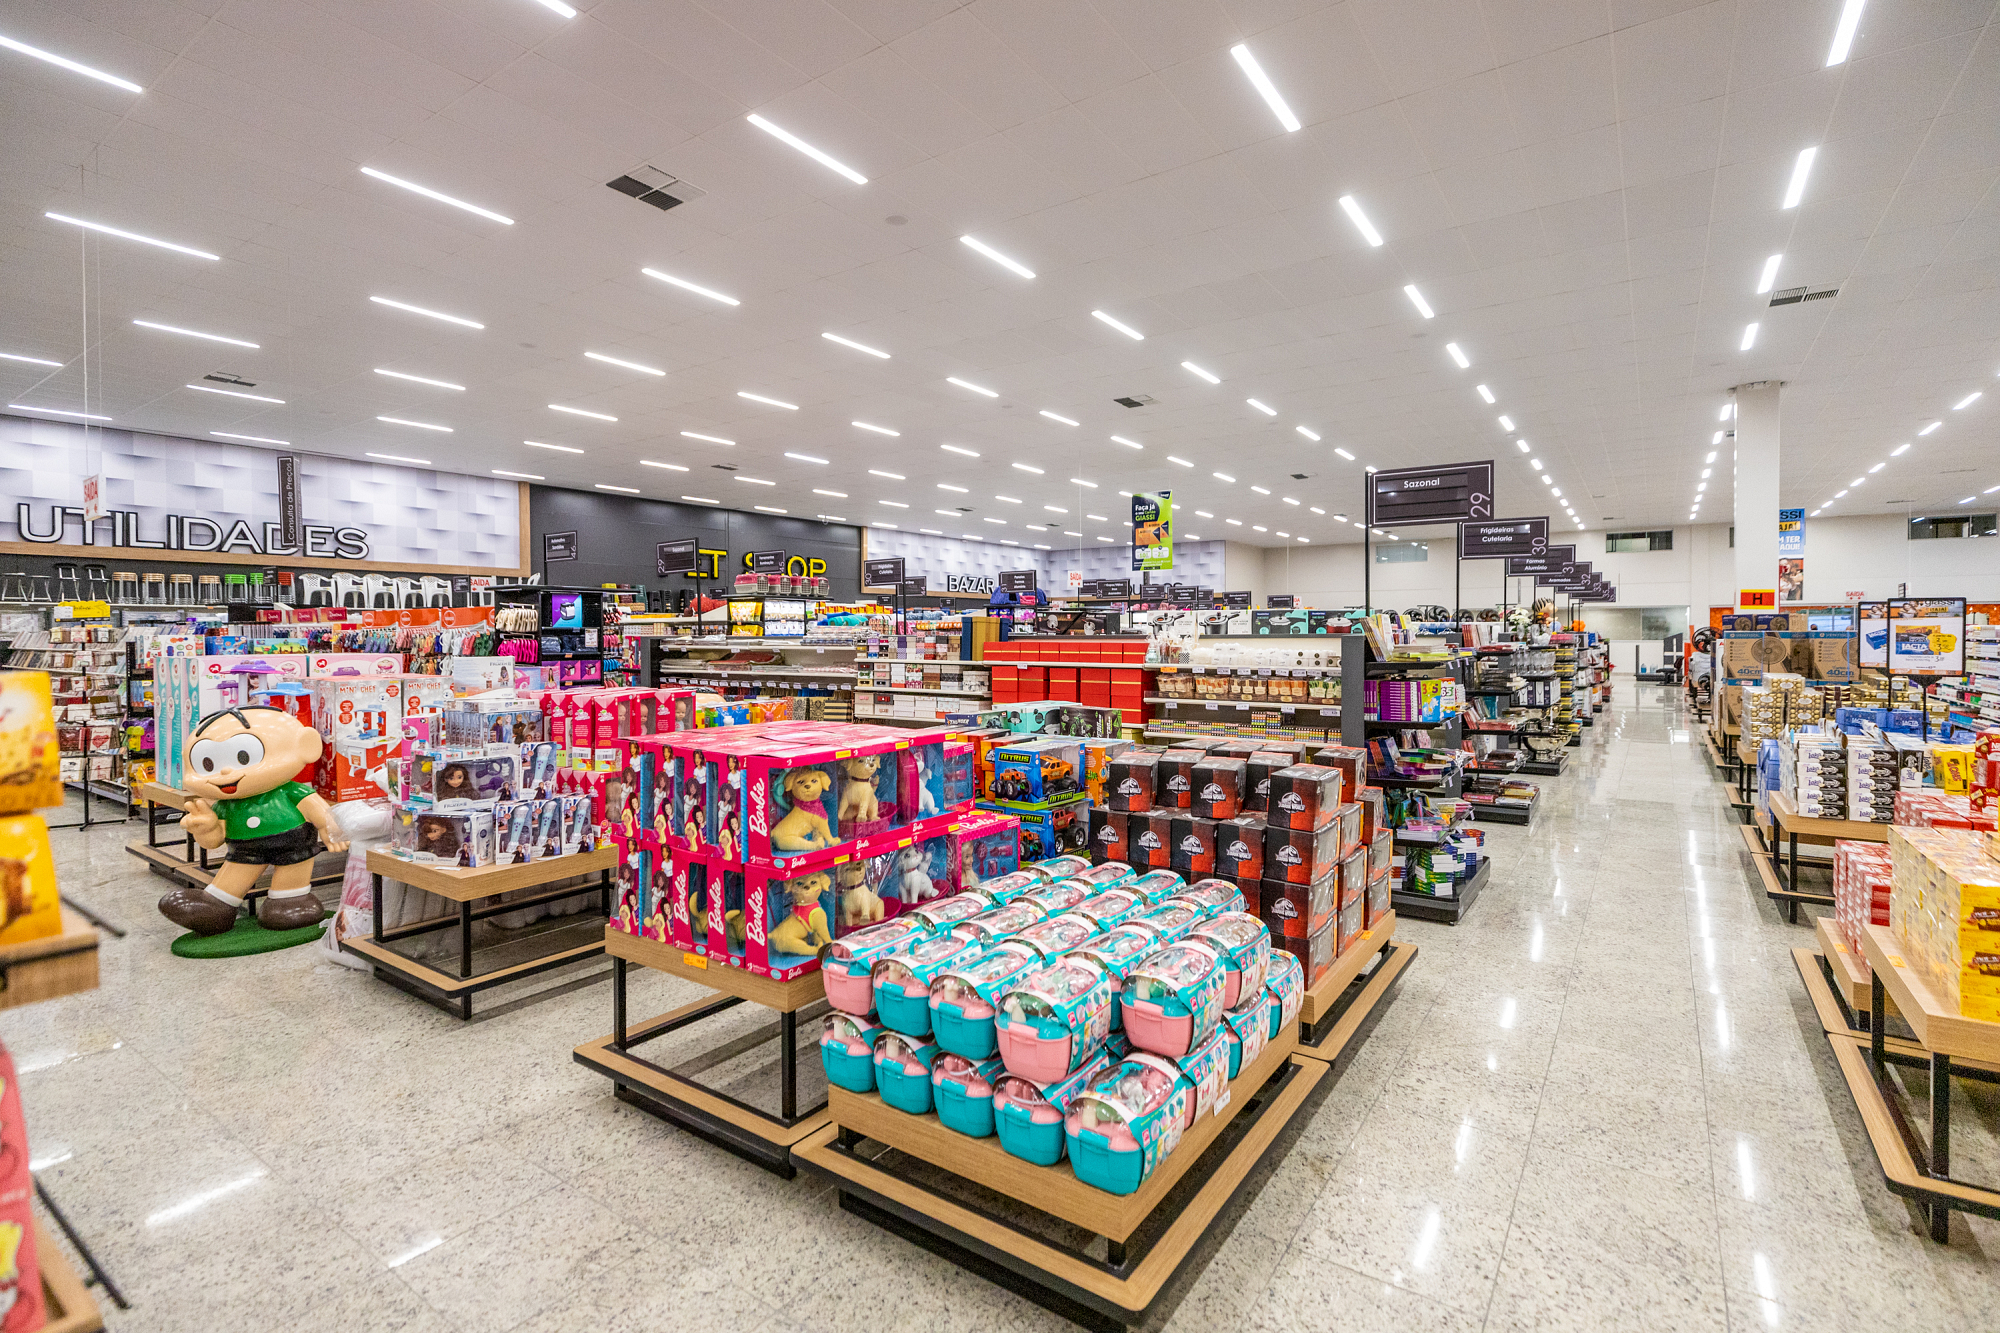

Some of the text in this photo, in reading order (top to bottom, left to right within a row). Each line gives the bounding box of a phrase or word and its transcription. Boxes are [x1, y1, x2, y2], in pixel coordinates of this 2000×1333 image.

[1403, 478, 1440, 488] Sazonal
[287, 490, 294, 503] de
[1470, 492, 1491, 517] 29
[287, 502, 295, 541] Consulta
[1480, 527, 1514, 535] Frigideiras
[1482, 535, 1513, 543] Cutelaria
[570, 545, 577, 559] 46
[1532, 537, 1547, 556] 30
[658, 559, 665, 573] 29
[779, 561, 785, 572] 45
[1562, 561, 1574, 574] 31
[865, 573, 872, 585] 30
[1070, 572, 1082, 581] SAÍDA
[1581, 573, 1591, 585] 32
[948, 575, 994, 594] BAZAR
[1752, 593, 1762, 605] H
[360, 685, 376, 693] CHEF
[426, 681, 441, 690] CHEF
[1422, 681, 1439, 695] 365
[999, 753, 1031, 764] NITRUS
[1048, 790, 1075, 805] NITRUS
[748, 777, 768, 837] Barbie
[855, 839, 870, 850] Barbie
[791, 857, 807, 869] Barbie
[673, 869, 689, 926] Barbie
[708, 877, 724, 935] Barbie
[746, 886, 765, 946] Barbie
[788, 967, 803, 980] Barbie
